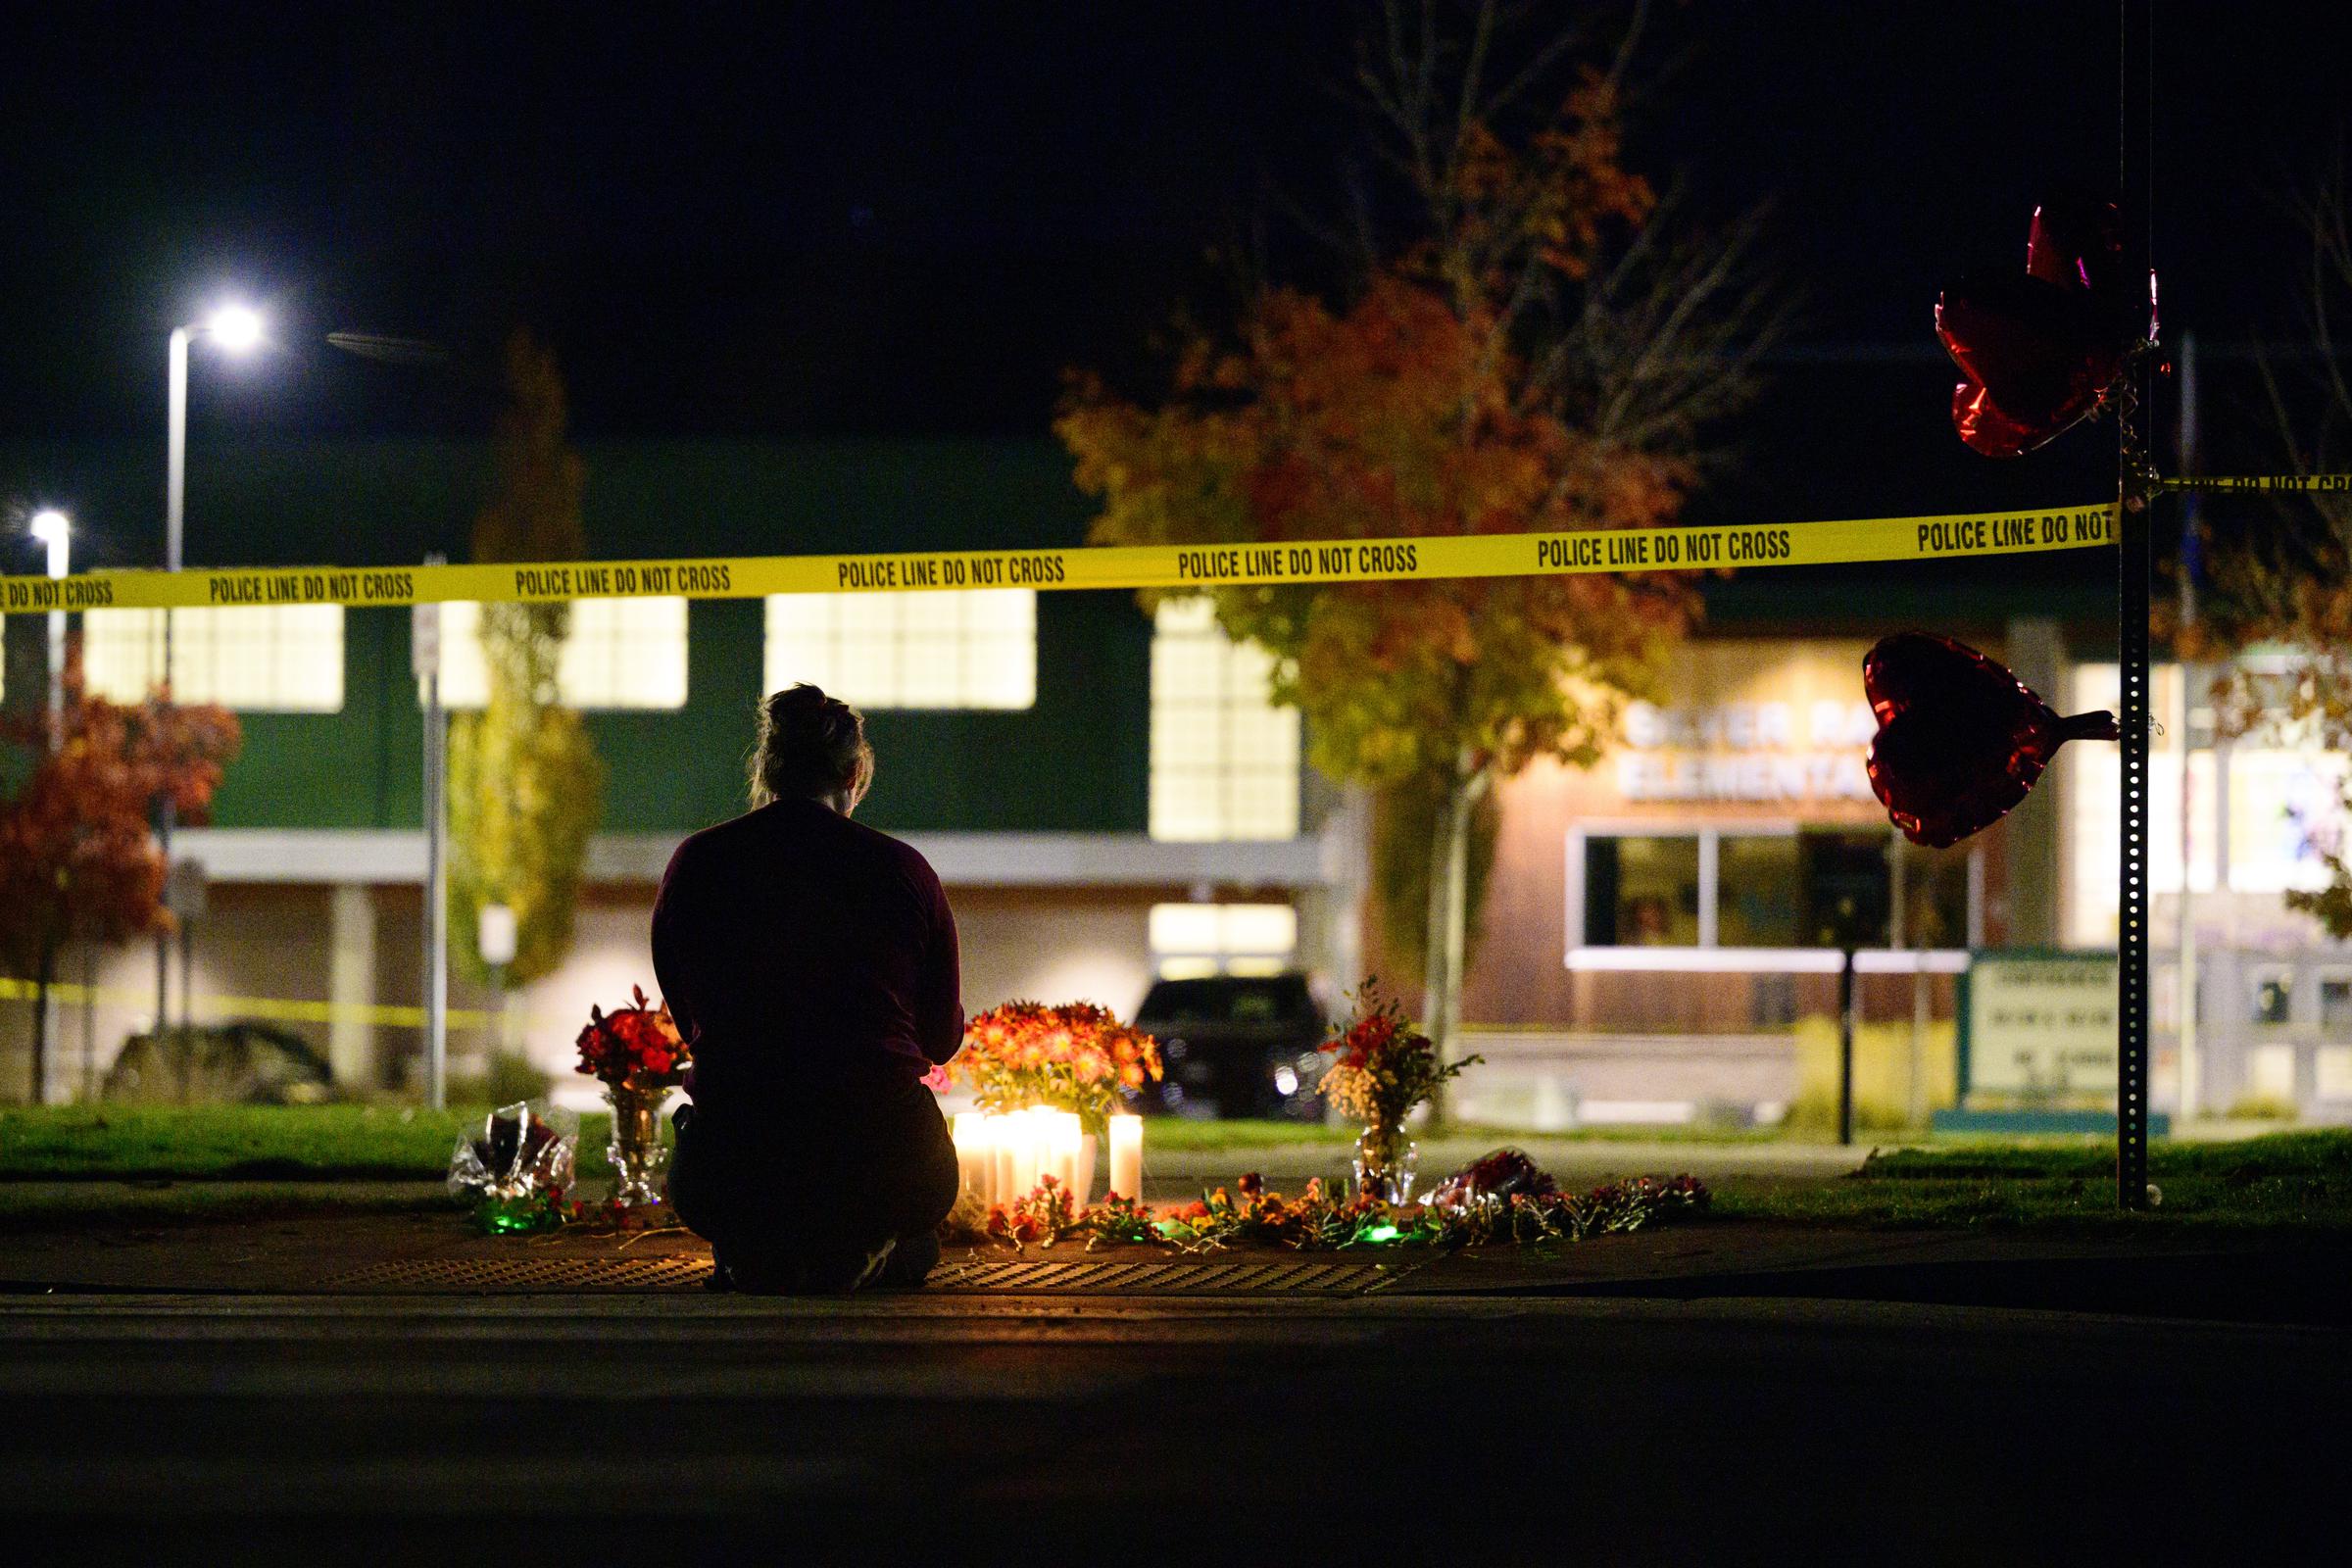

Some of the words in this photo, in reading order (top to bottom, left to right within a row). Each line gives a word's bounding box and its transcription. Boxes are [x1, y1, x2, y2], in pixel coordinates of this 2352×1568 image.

[1917, 520, 1985, 553] POLICE
[1992, 517, 2035, 547] LINE
[2041, 514, 2068, 544] DO
[2075, 510, 2113, 541] NOT
[1178, 551, 1240, 578] POLICE
[1245, 549, 1283, 576] LINE
[1289, 548, 1313, 575] DO
[1319, 547, 1352, 574] NOT
[1358, 545, 1417, 572] CROSS
[1538, 538, 1602, 567] POLICE
[1608, 536, 1648, 564] LINE
[1655, 534, 1680, 564] DO
[1686, 533, 1722, 563] NOT
[1728, 530, 1790, 561] CROSS
[209, 576, 262, 604] POLICE
[267, 575, 299, 602] LINE
[304, 574, 325, 600] DO
[327, 574, 359, 598] NOT
[363, 572, 414, 598] CROSS
[515, 568, 570, 596] POLICE
[575, 568, 610, 595] LINE
[615, 566, 637, 593] DO
[641, 566, 673, 592] NOT
[677, 564, 731, 591] CROSS
[838, 561, 897, 588] POLICE
[902, 561, 938, 586] LINE
[943, 559, 965, 585] DO
[971, 558, 1004, 584] NOT
[1008, 555, 1065, 582] CROSS
[8, 582, 28, 607] DO
[32, 579, 60, 606] NOT
[65, 578, 114, 606] CROSS
